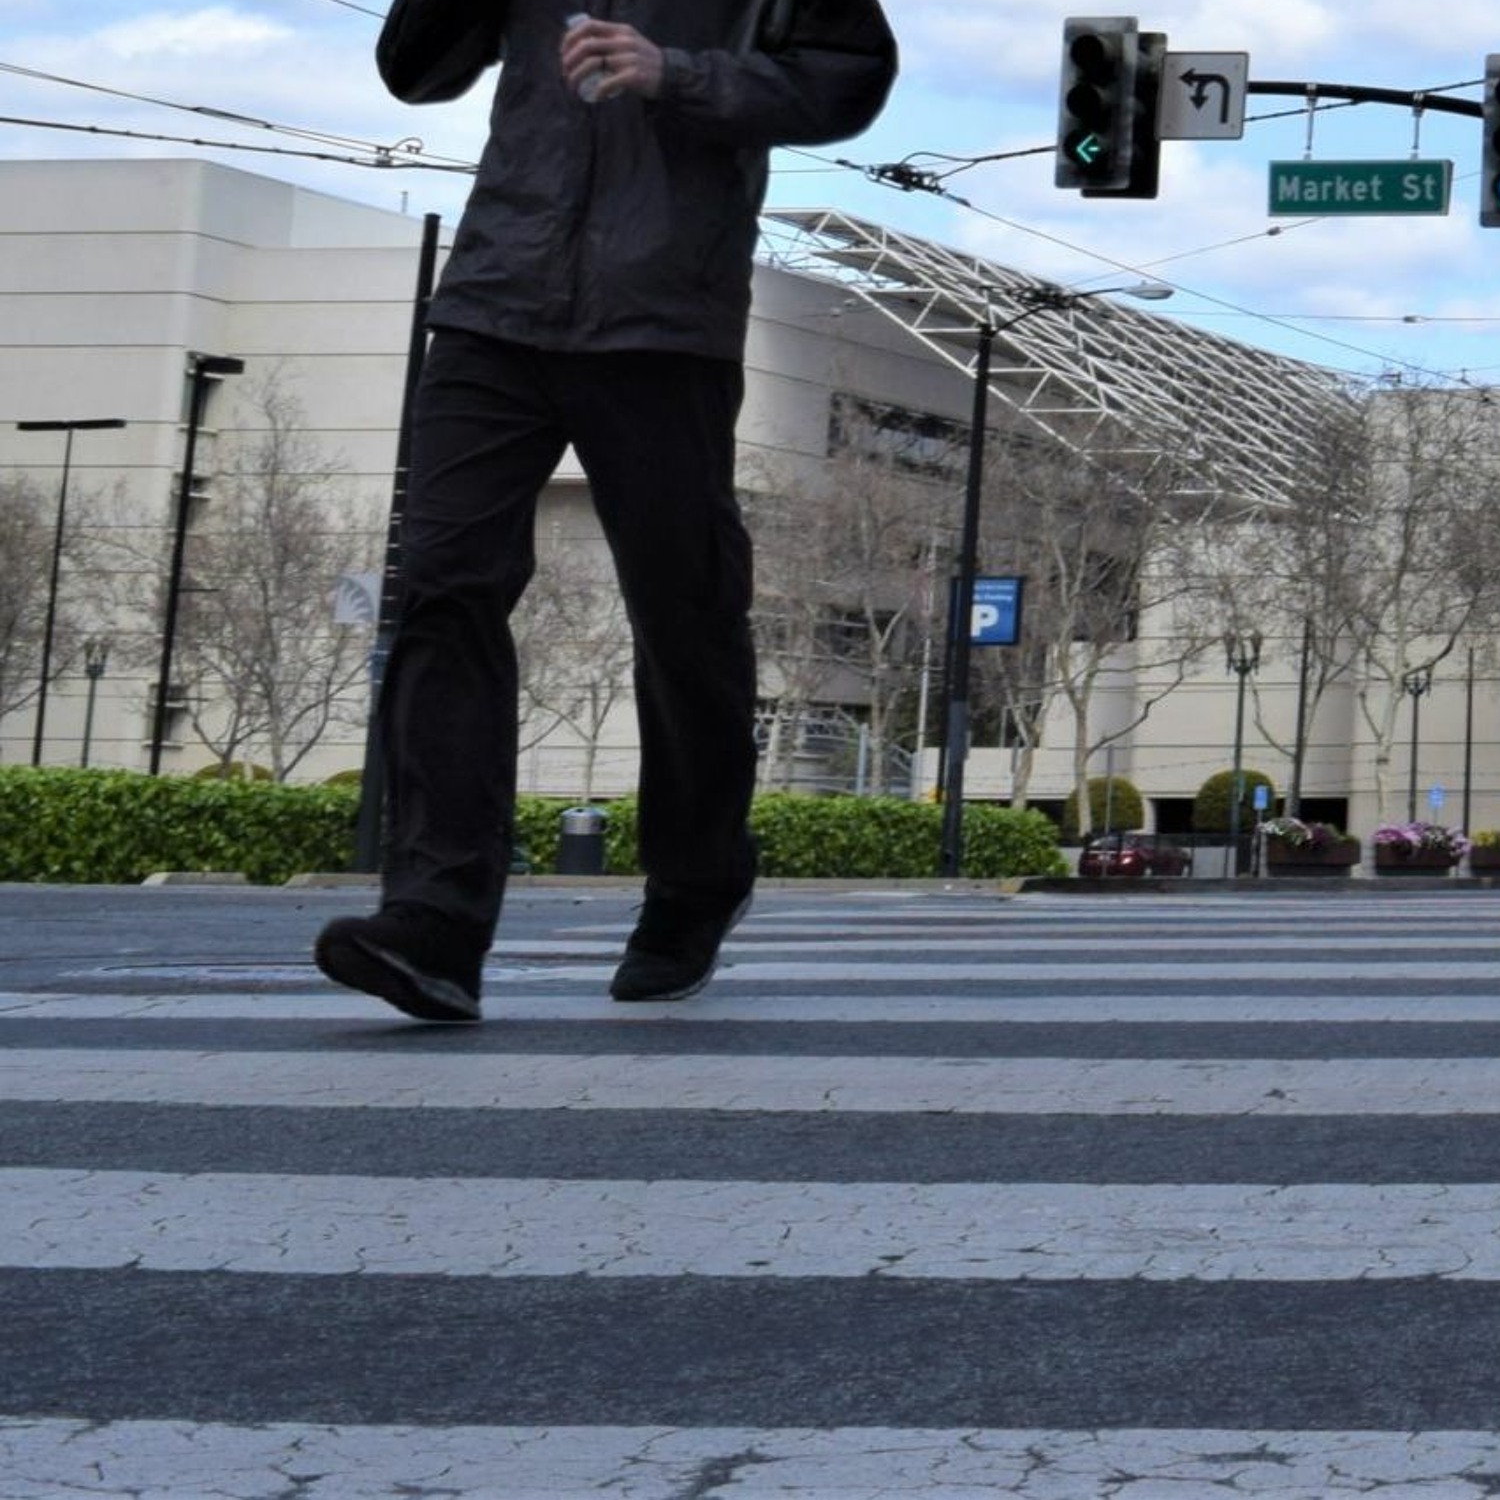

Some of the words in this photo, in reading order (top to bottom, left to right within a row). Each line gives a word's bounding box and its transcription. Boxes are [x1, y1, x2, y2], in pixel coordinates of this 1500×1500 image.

[1277, 173, 1383, 202] Market
[1402, 173, 1436, 201] St
[971, 604, 999, 637] P
